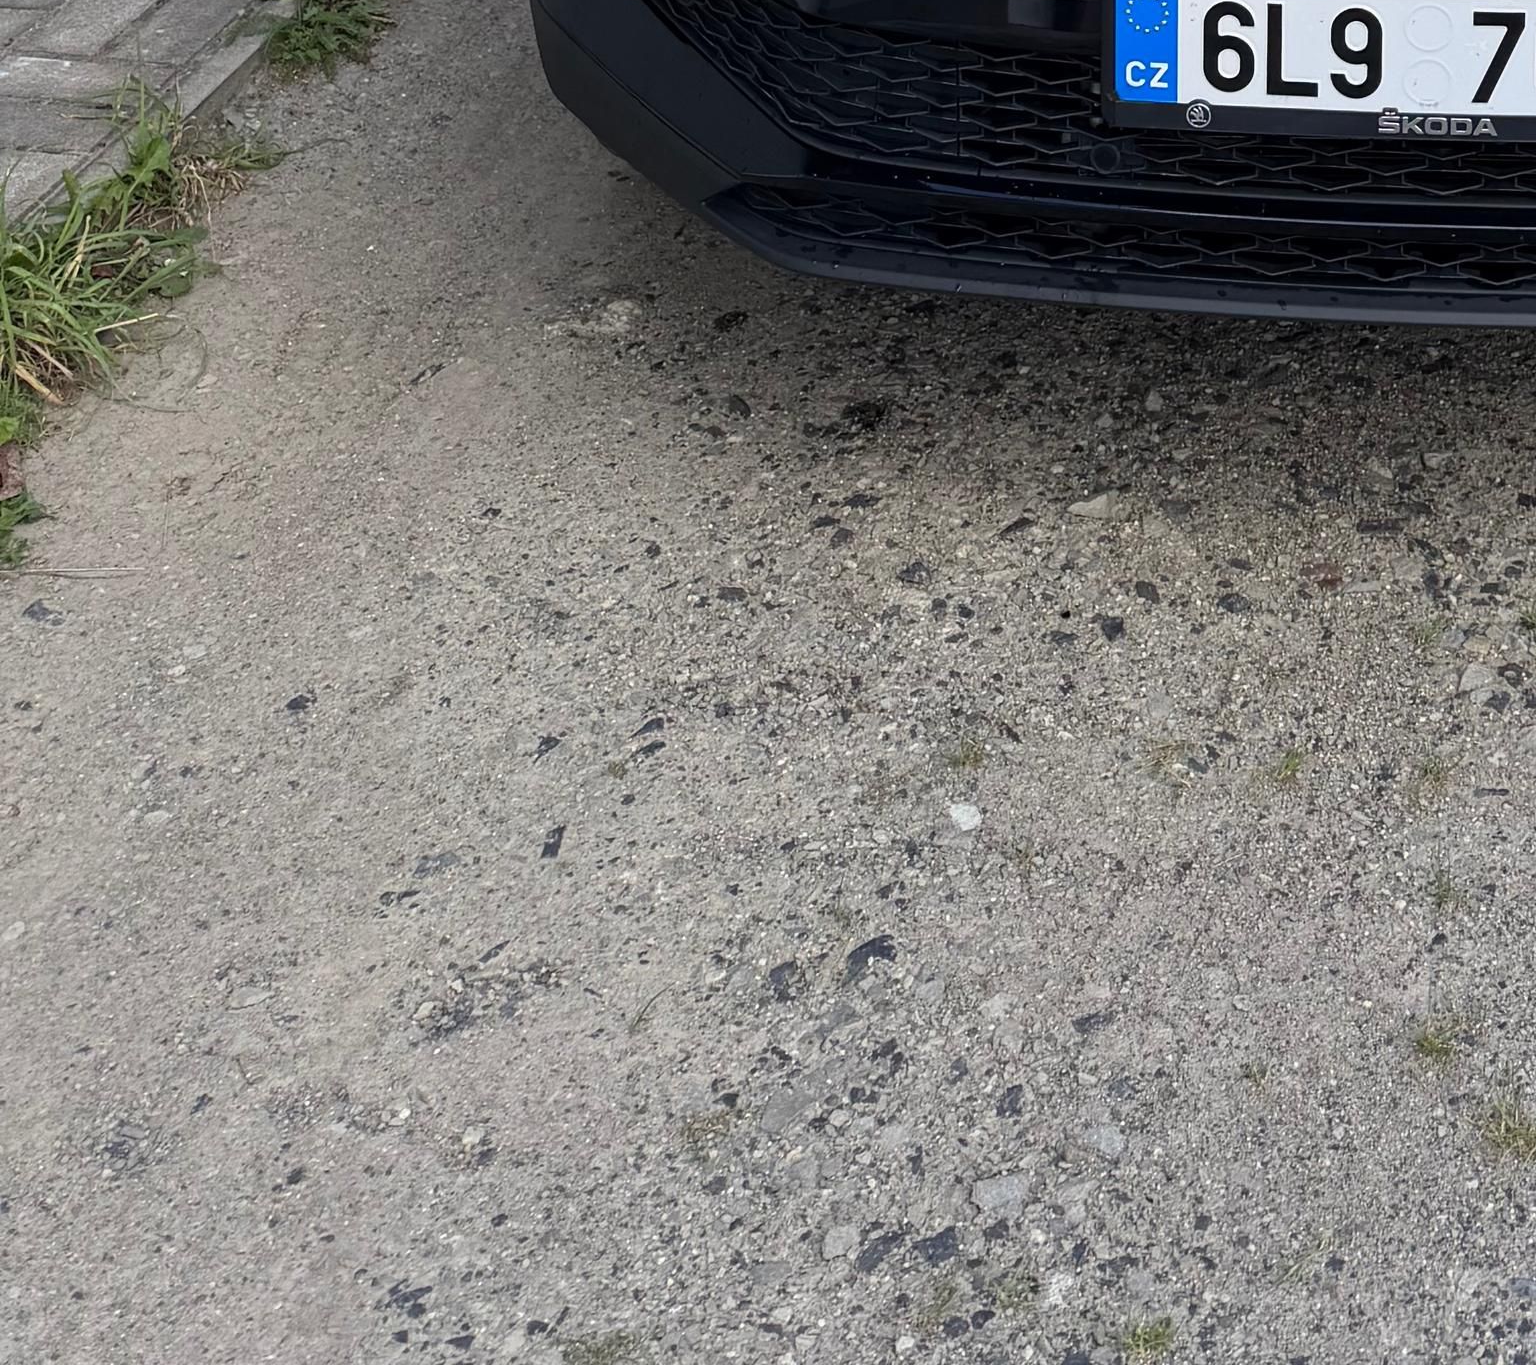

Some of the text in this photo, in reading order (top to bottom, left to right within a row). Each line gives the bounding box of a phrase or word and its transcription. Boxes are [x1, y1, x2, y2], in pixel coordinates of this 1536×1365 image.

[1203, 0, 1383, 99] 6L9
[1125, 60, 1169, 89] CZ
[1377, 109, 1498, 137] ŠKODA
